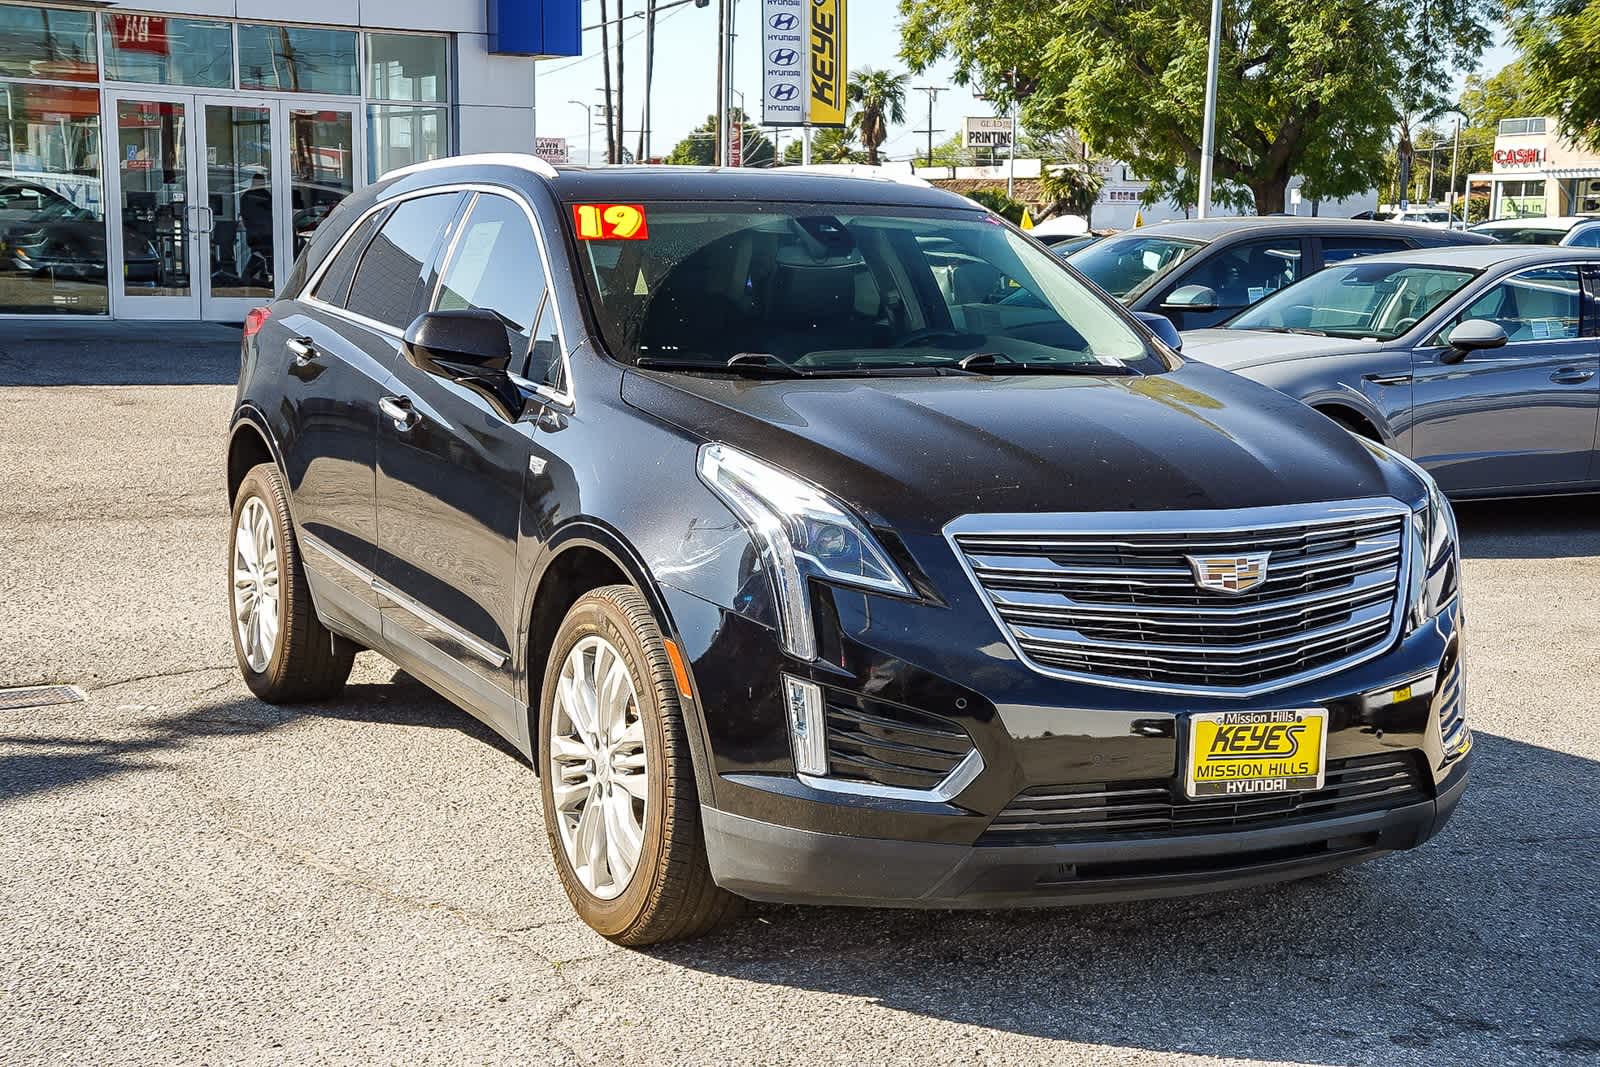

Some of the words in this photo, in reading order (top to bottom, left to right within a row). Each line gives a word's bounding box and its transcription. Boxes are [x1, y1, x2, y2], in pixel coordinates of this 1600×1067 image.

[536, 141, 559, 149] LAWN
[536, 148, 565, 156] OWERS
[577, 204, 643, 238] 19
[1226, 713, 1267, 724] Mission
[1270, 711, 1295, 723] Hills
[1207, 725, 1306, 760] KEYES
[1197, 763, 1263, 778] MISSION
[1268, 762, 1309, 776] HILLS
[1226, 778, 1287, 793] HYUNDAI
